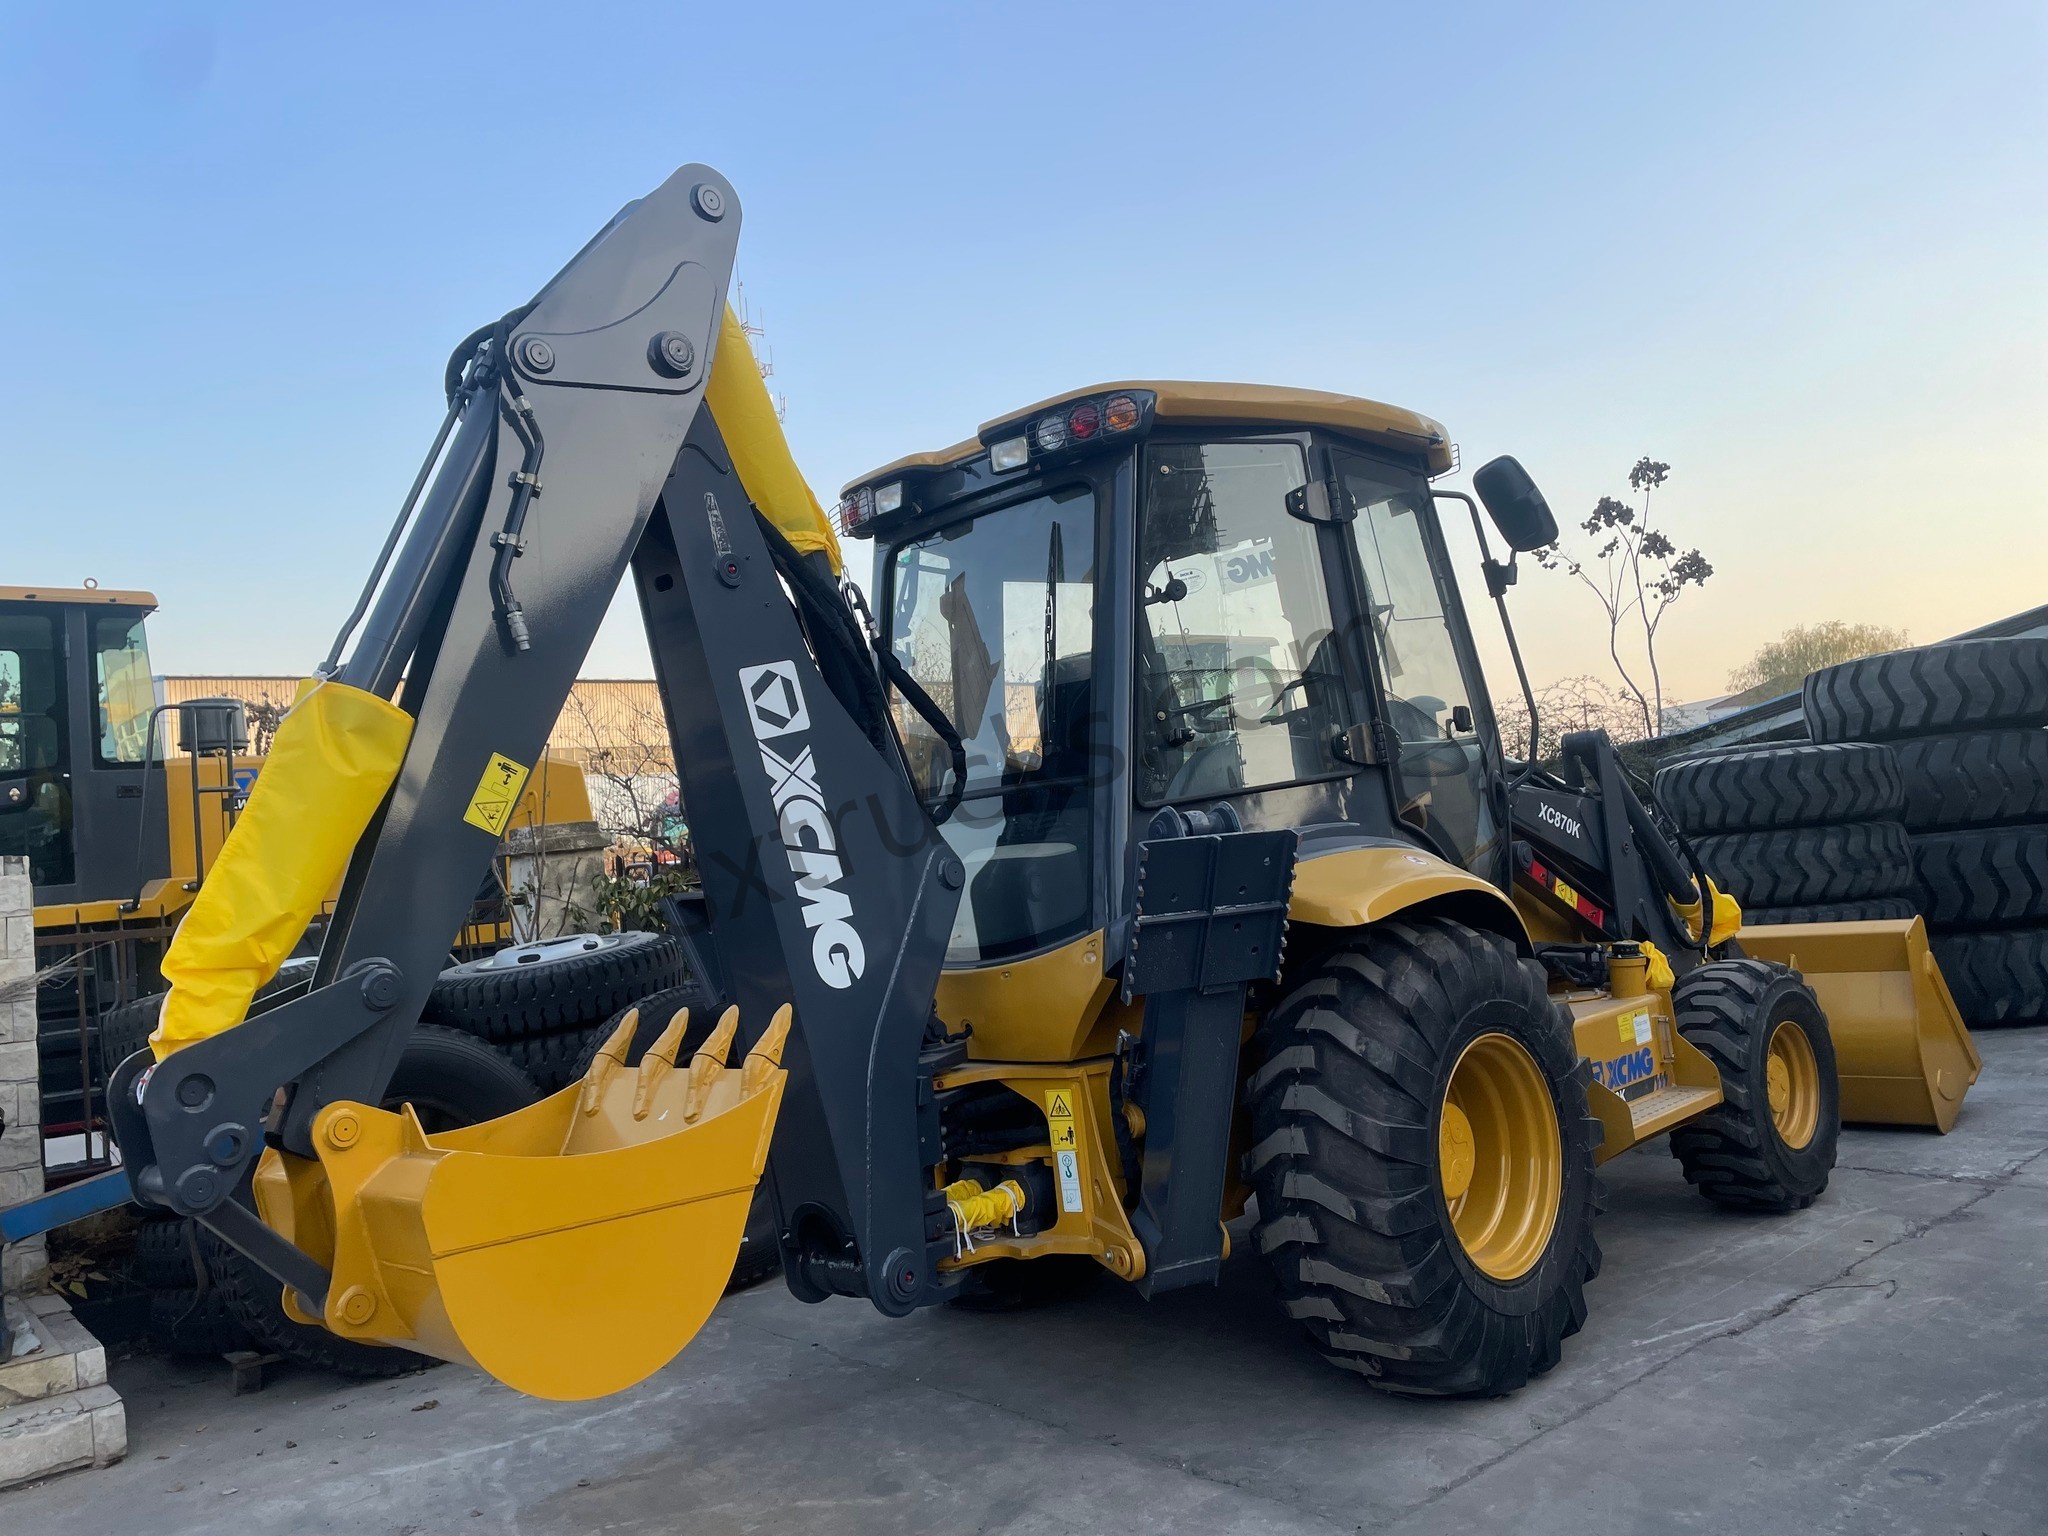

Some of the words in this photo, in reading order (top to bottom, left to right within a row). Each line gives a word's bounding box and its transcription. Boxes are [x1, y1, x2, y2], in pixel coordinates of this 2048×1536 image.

[1538, 802, 1581, 838] XC870K
[758, 740, 866, 989] XCMG
[1606, 1047, 1653, 1089] XCMG
